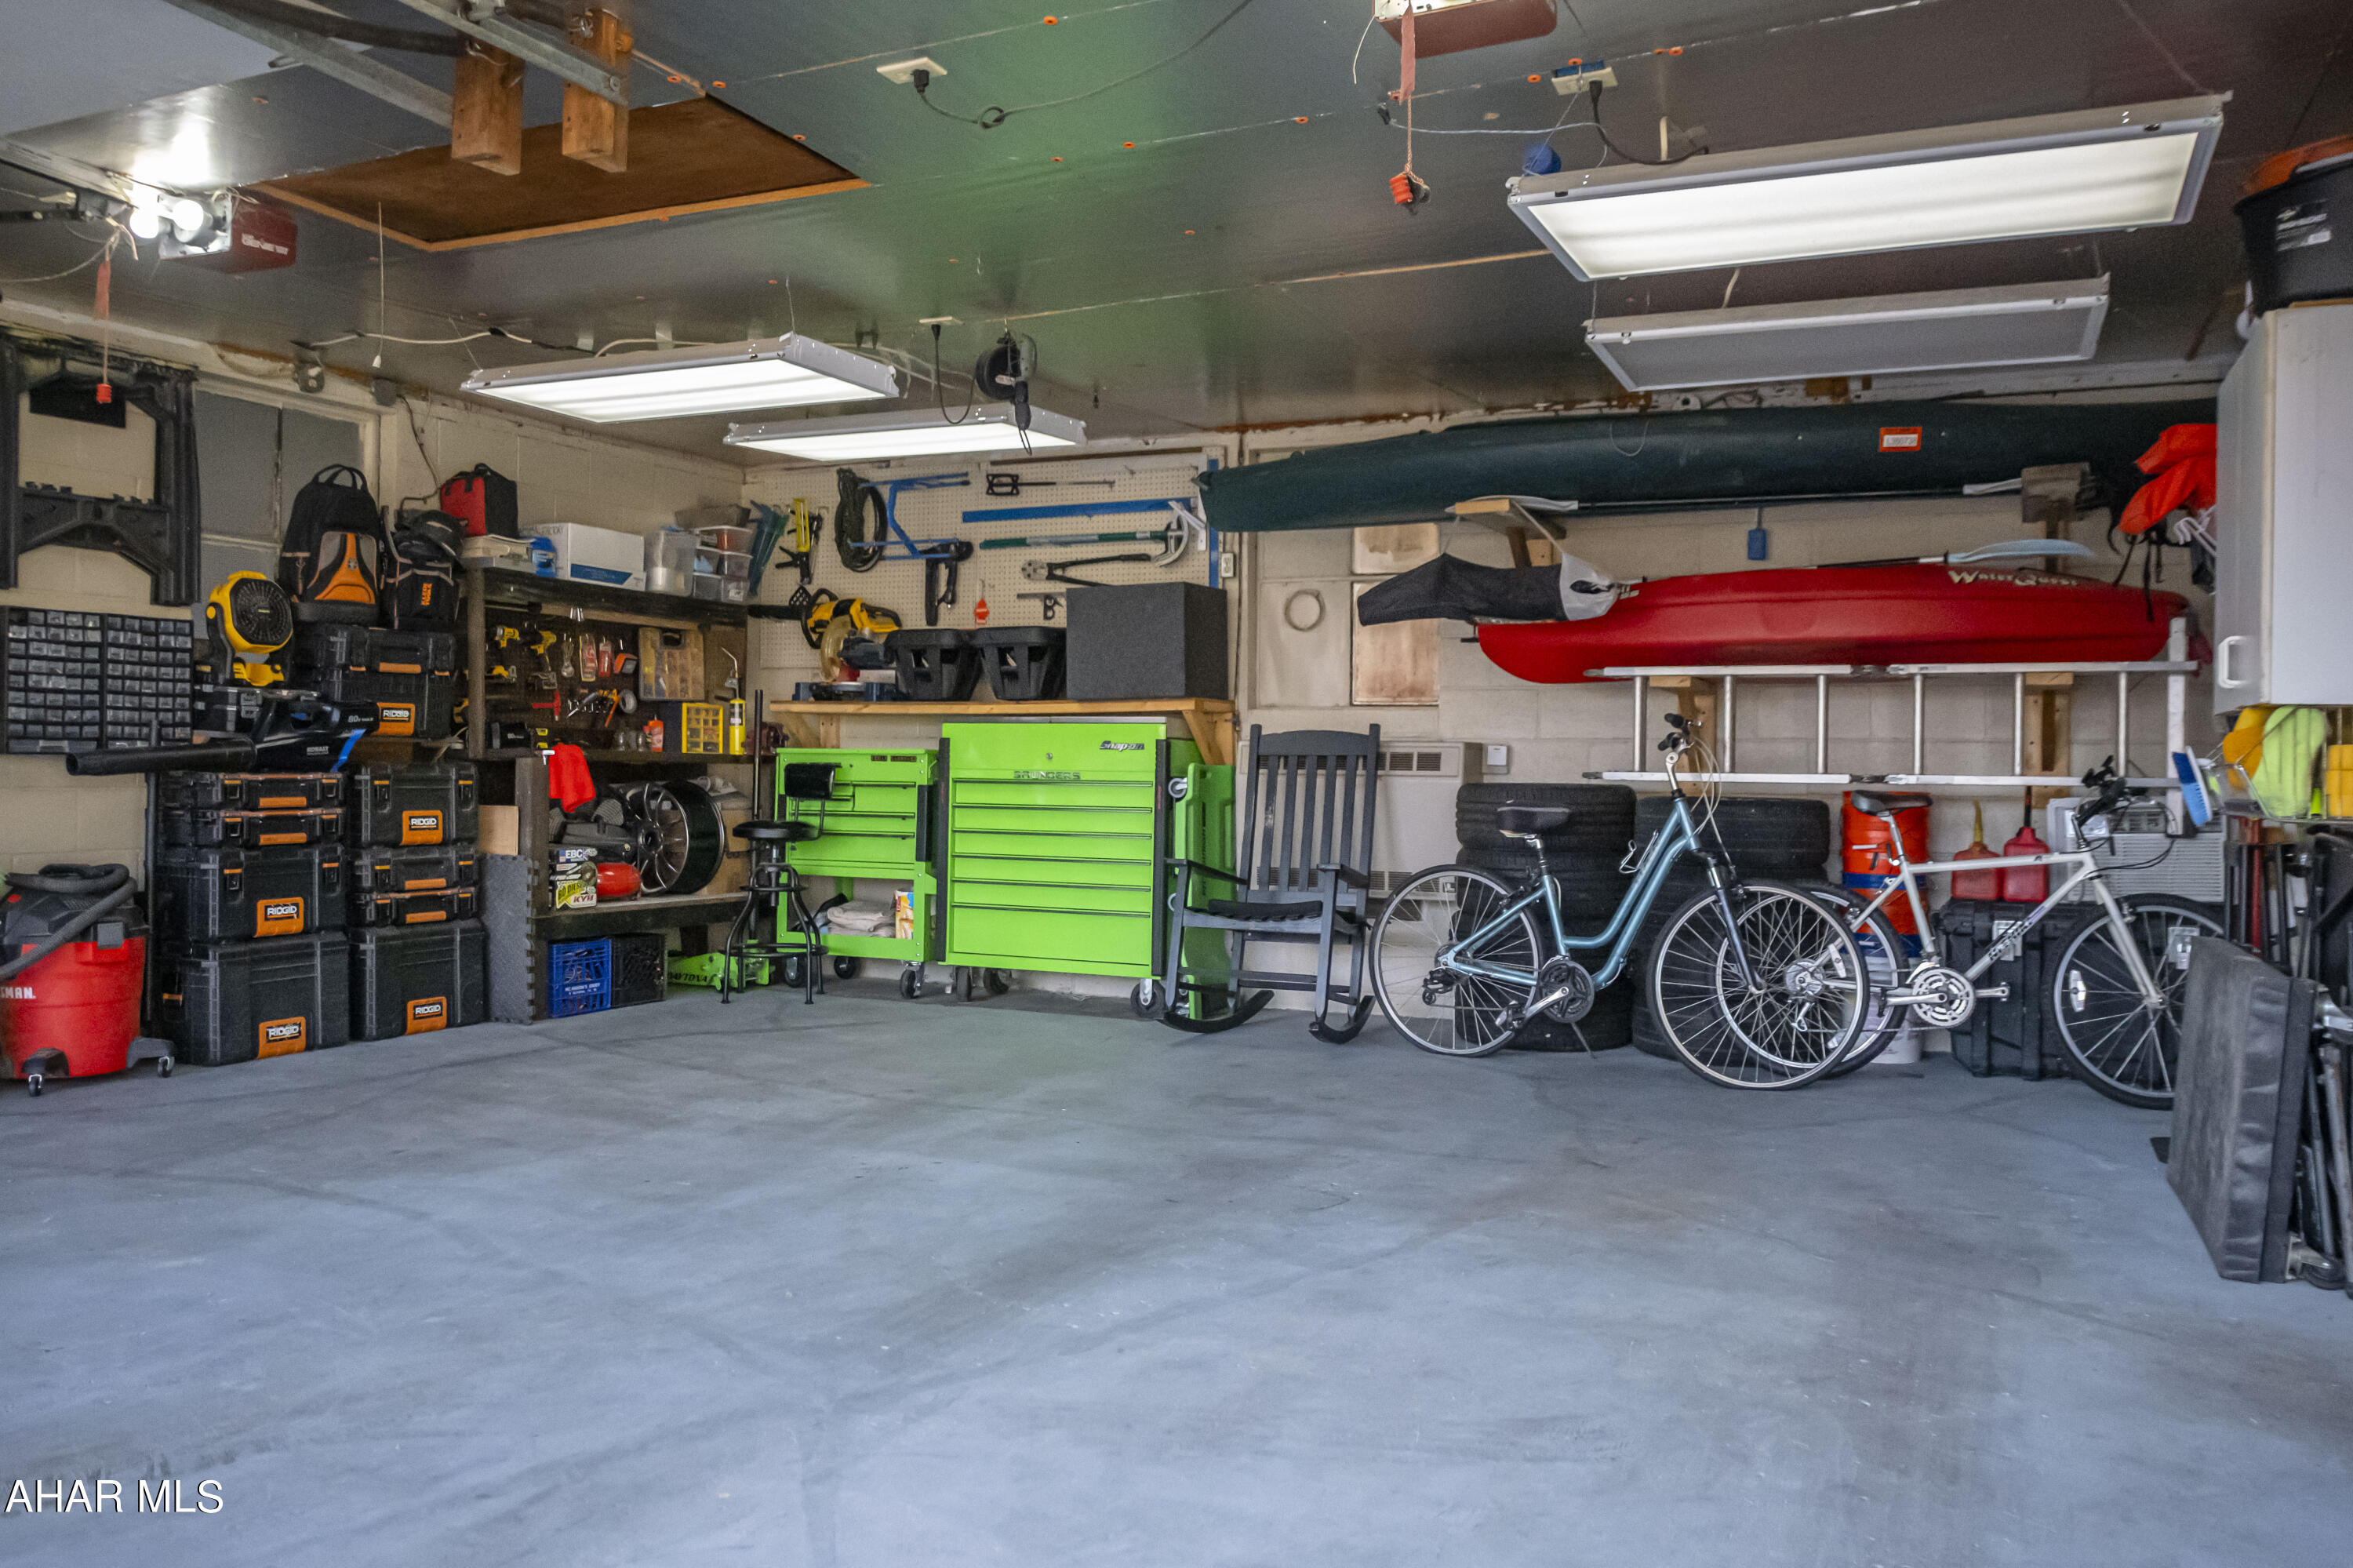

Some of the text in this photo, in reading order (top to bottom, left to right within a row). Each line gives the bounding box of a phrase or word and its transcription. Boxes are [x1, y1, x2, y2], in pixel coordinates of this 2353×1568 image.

[1013, 770, 1081, 780] SAUNDERS
[566, 849, 584, 858] EBC
[267, 905, 297, 915] RIDGID
[415, 1004, 442, 1014] RIDGID
[268, 1024, 300, 1037] RIDGID
